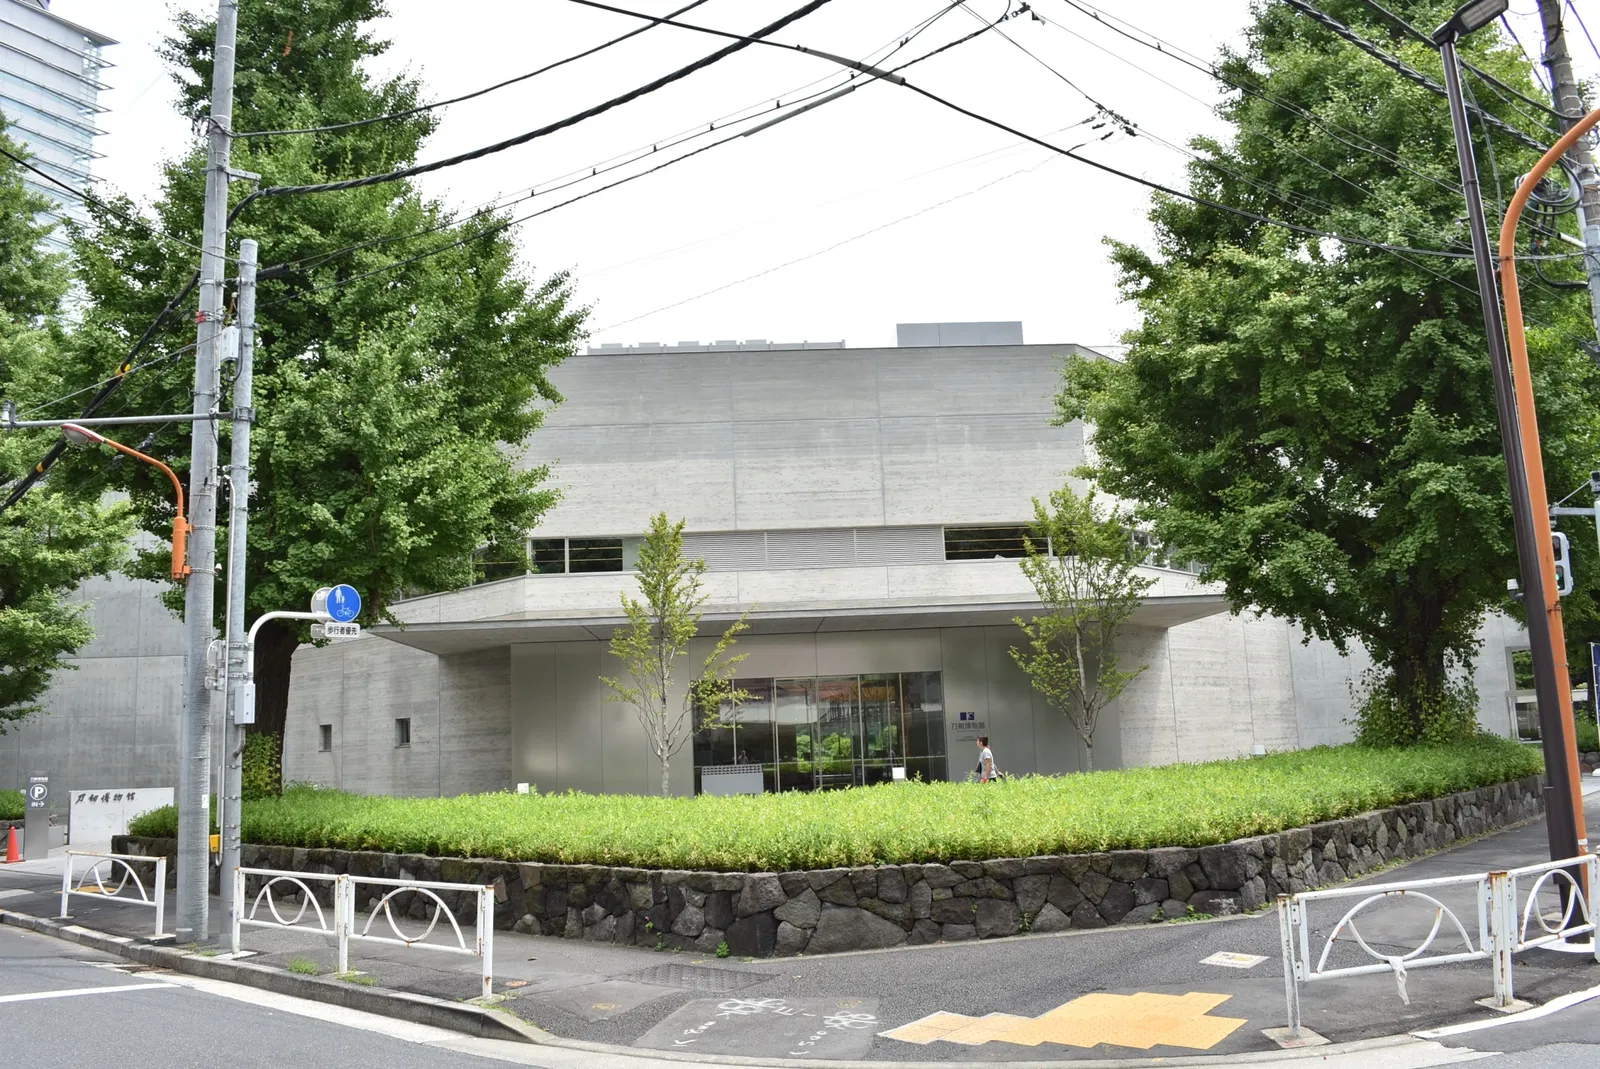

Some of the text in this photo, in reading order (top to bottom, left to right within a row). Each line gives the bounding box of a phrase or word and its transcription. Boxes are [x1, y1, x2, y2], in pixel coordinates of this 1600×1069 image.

[327, 626, 357, 635] 歩行者優先
[34, 786, 44, 798] P
